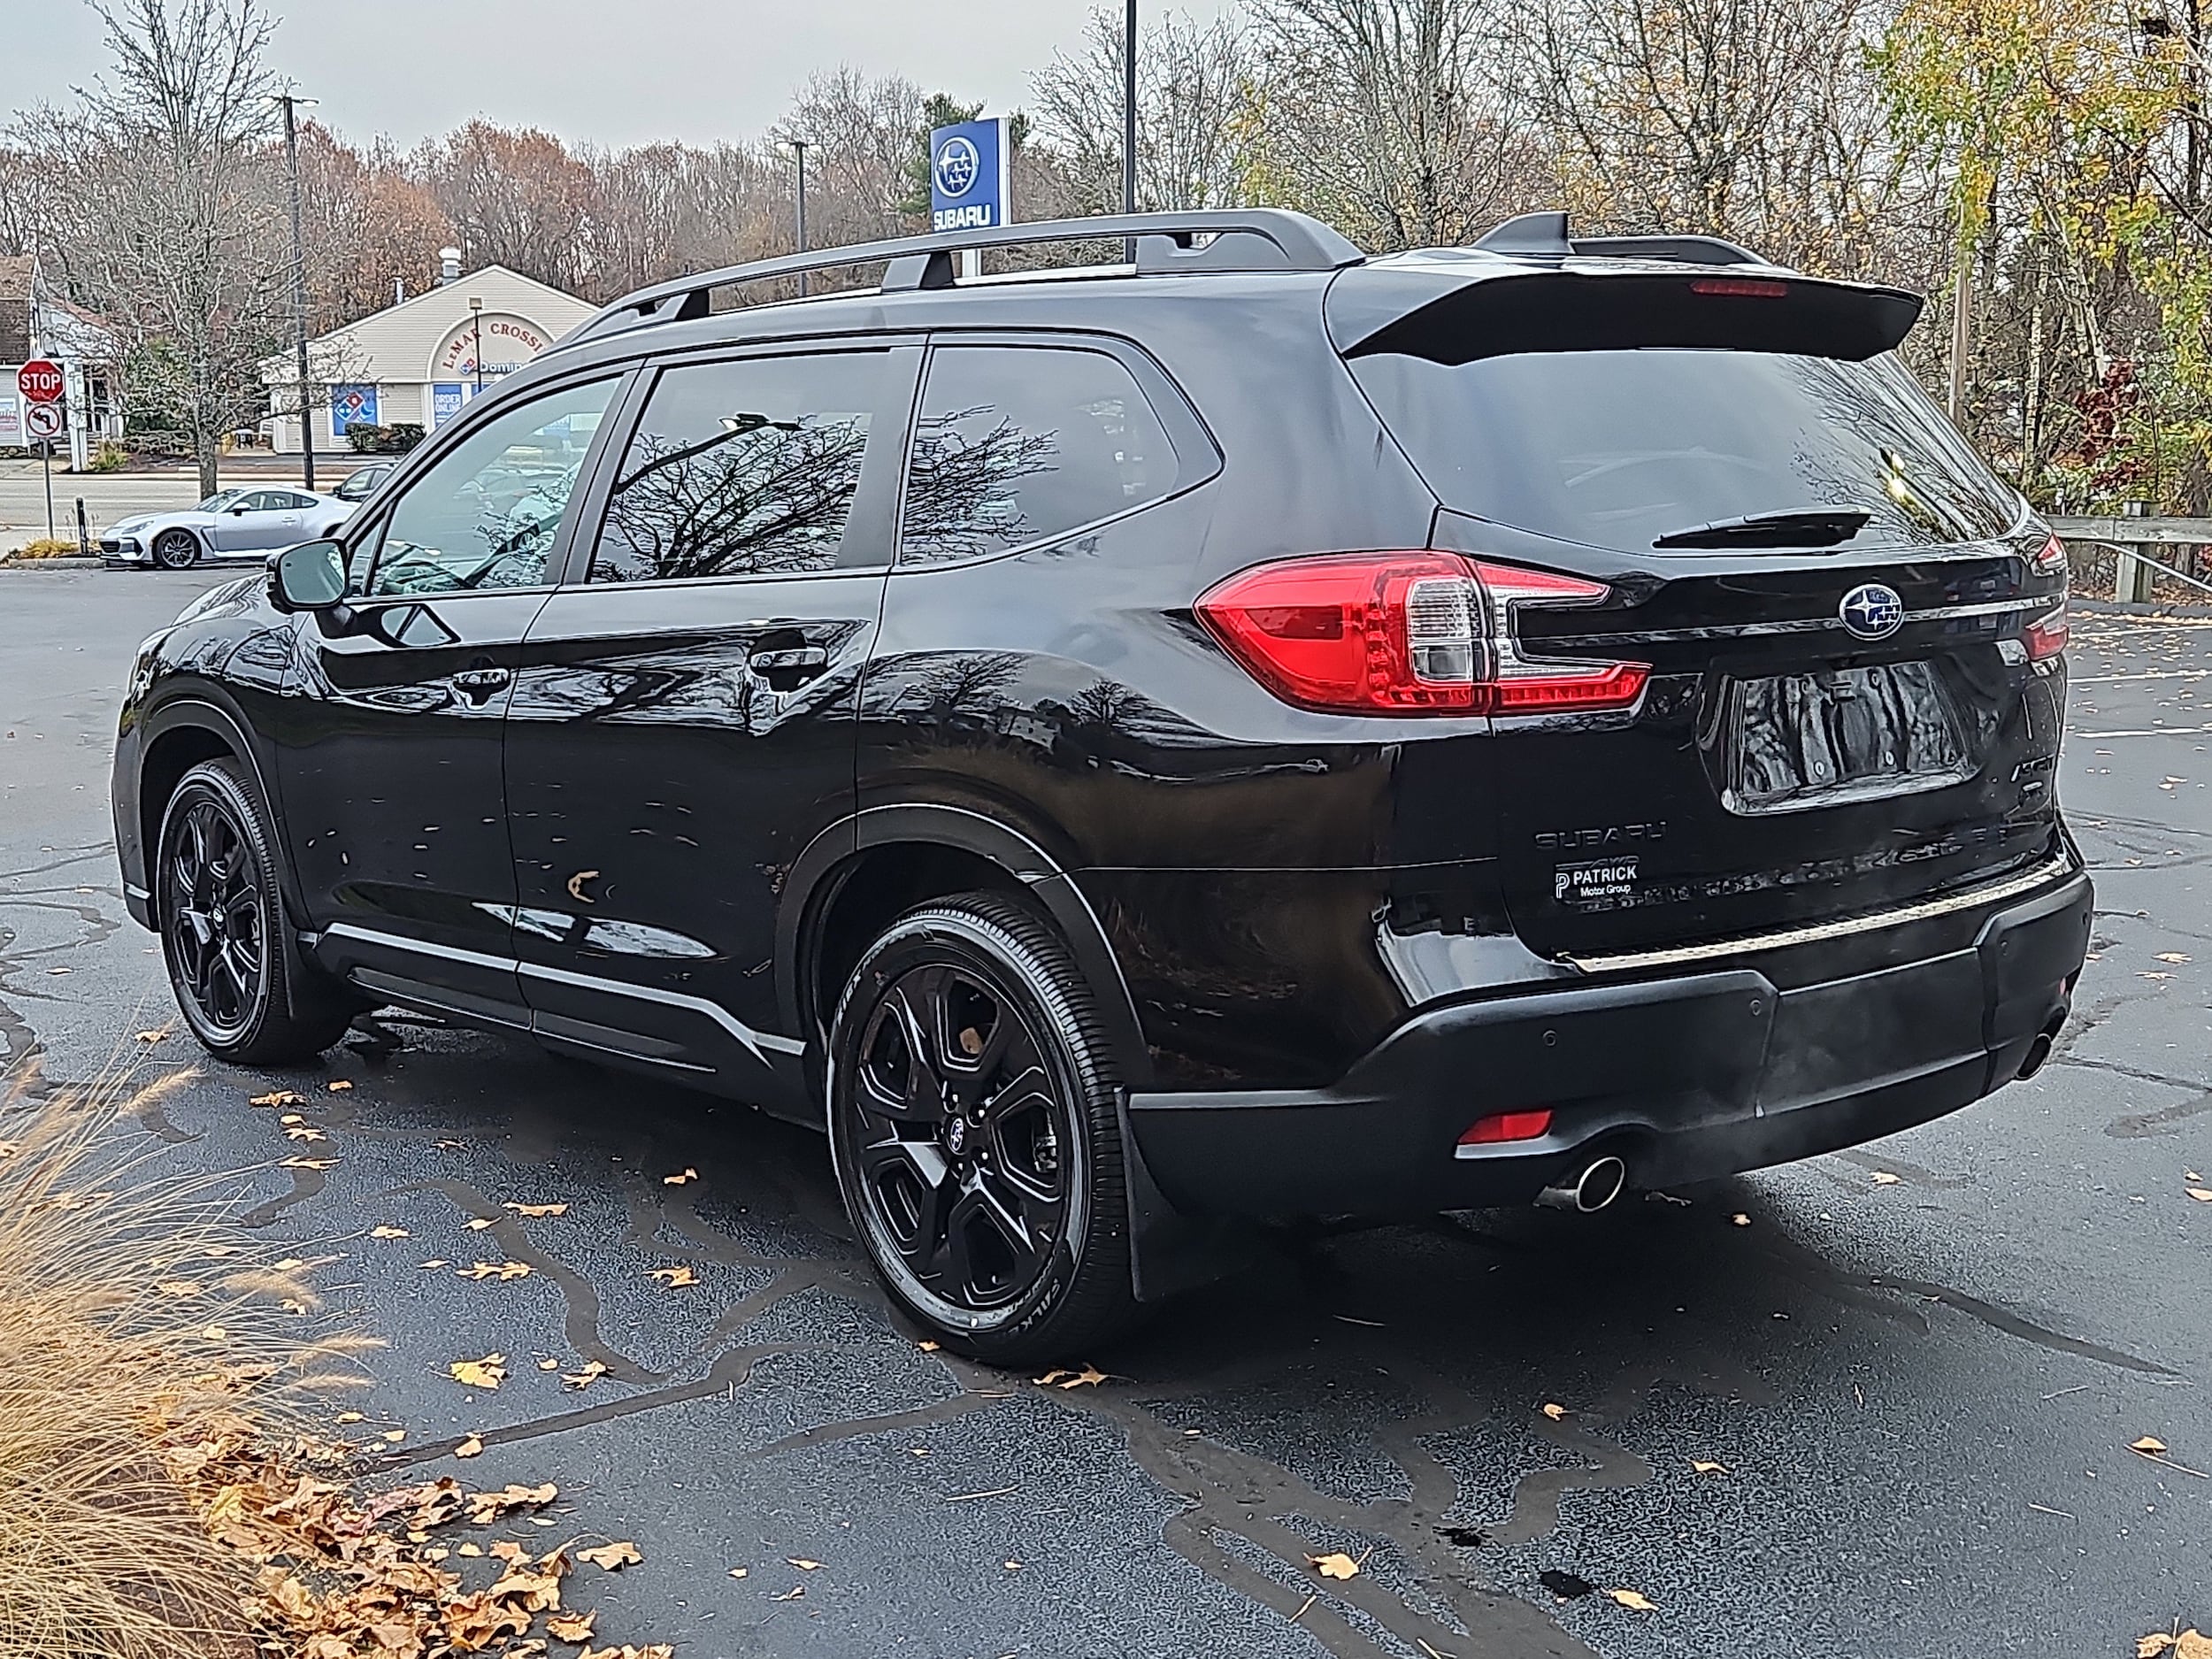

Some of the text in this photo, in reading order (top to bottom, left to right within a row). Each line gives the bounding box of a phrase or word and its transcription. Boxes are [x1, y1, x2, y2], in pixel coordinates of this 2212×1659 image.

[933, 204, 991, 231] SUBARU
[490, 323, 546, 352] CROSSI
[480, 360, 526, 373] Domin
[20, 373, 61, 390] STOP
[434, 394, 461, 403] ORDER
[1535, 821, 1667, 849] SUBARU
[1573, 865, 1637, 885] PATRICK
[1580, 887, 1605, 897] Motor
